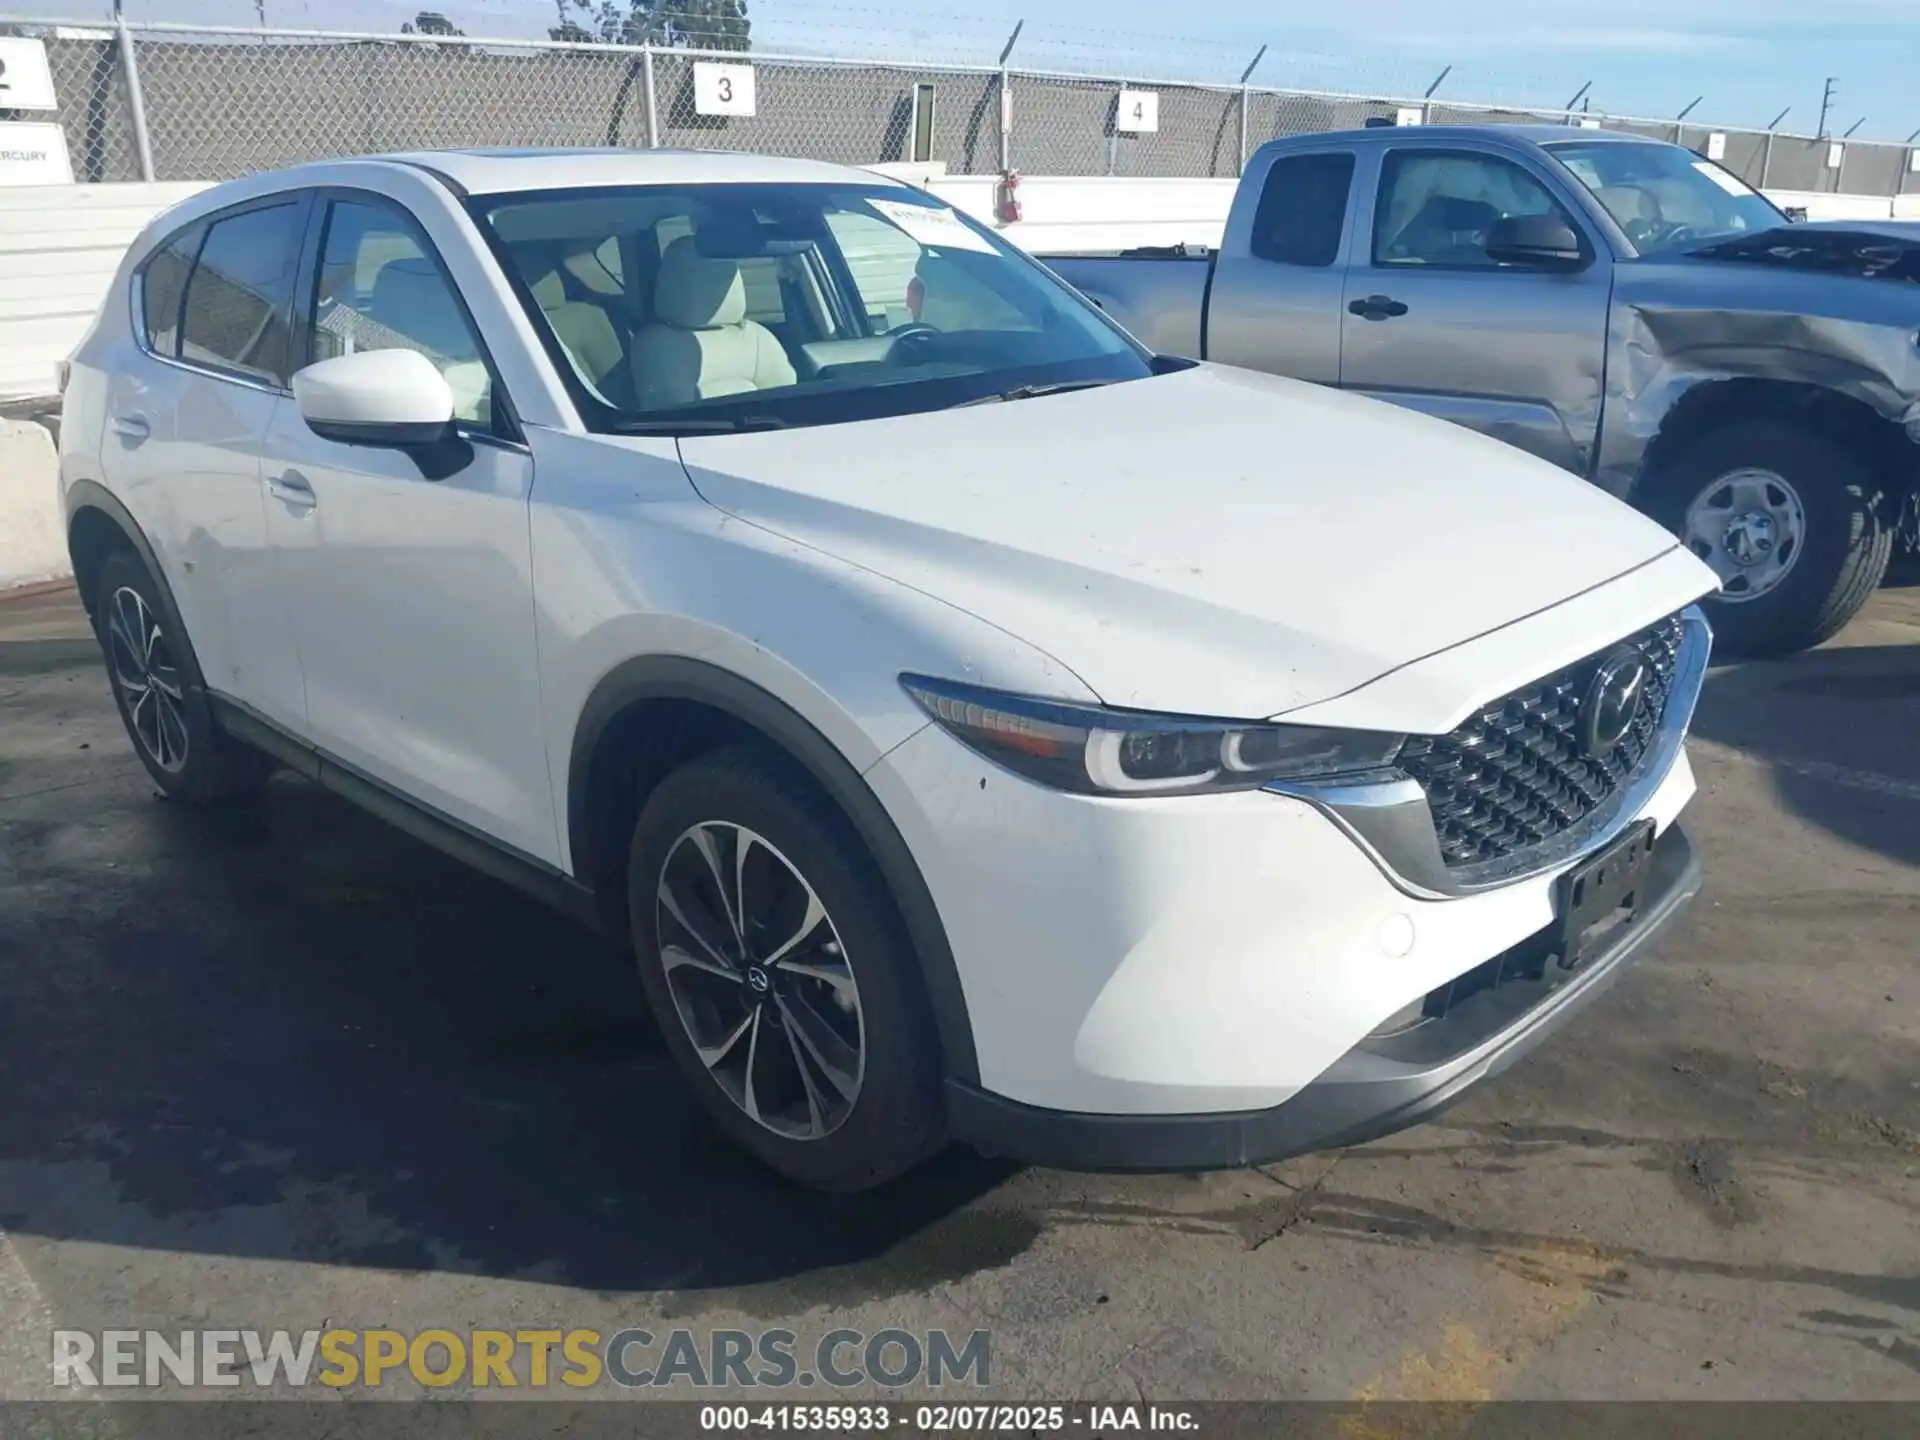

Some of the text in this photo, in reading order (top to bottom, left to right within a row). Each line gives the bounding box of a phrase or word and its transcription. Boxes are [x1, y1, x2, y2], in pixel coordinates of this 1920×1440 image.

[718, 77, 732, 102] 3
[1133, 102, 1143, 121] 4
[0, 150, 47, 162] RCURY
